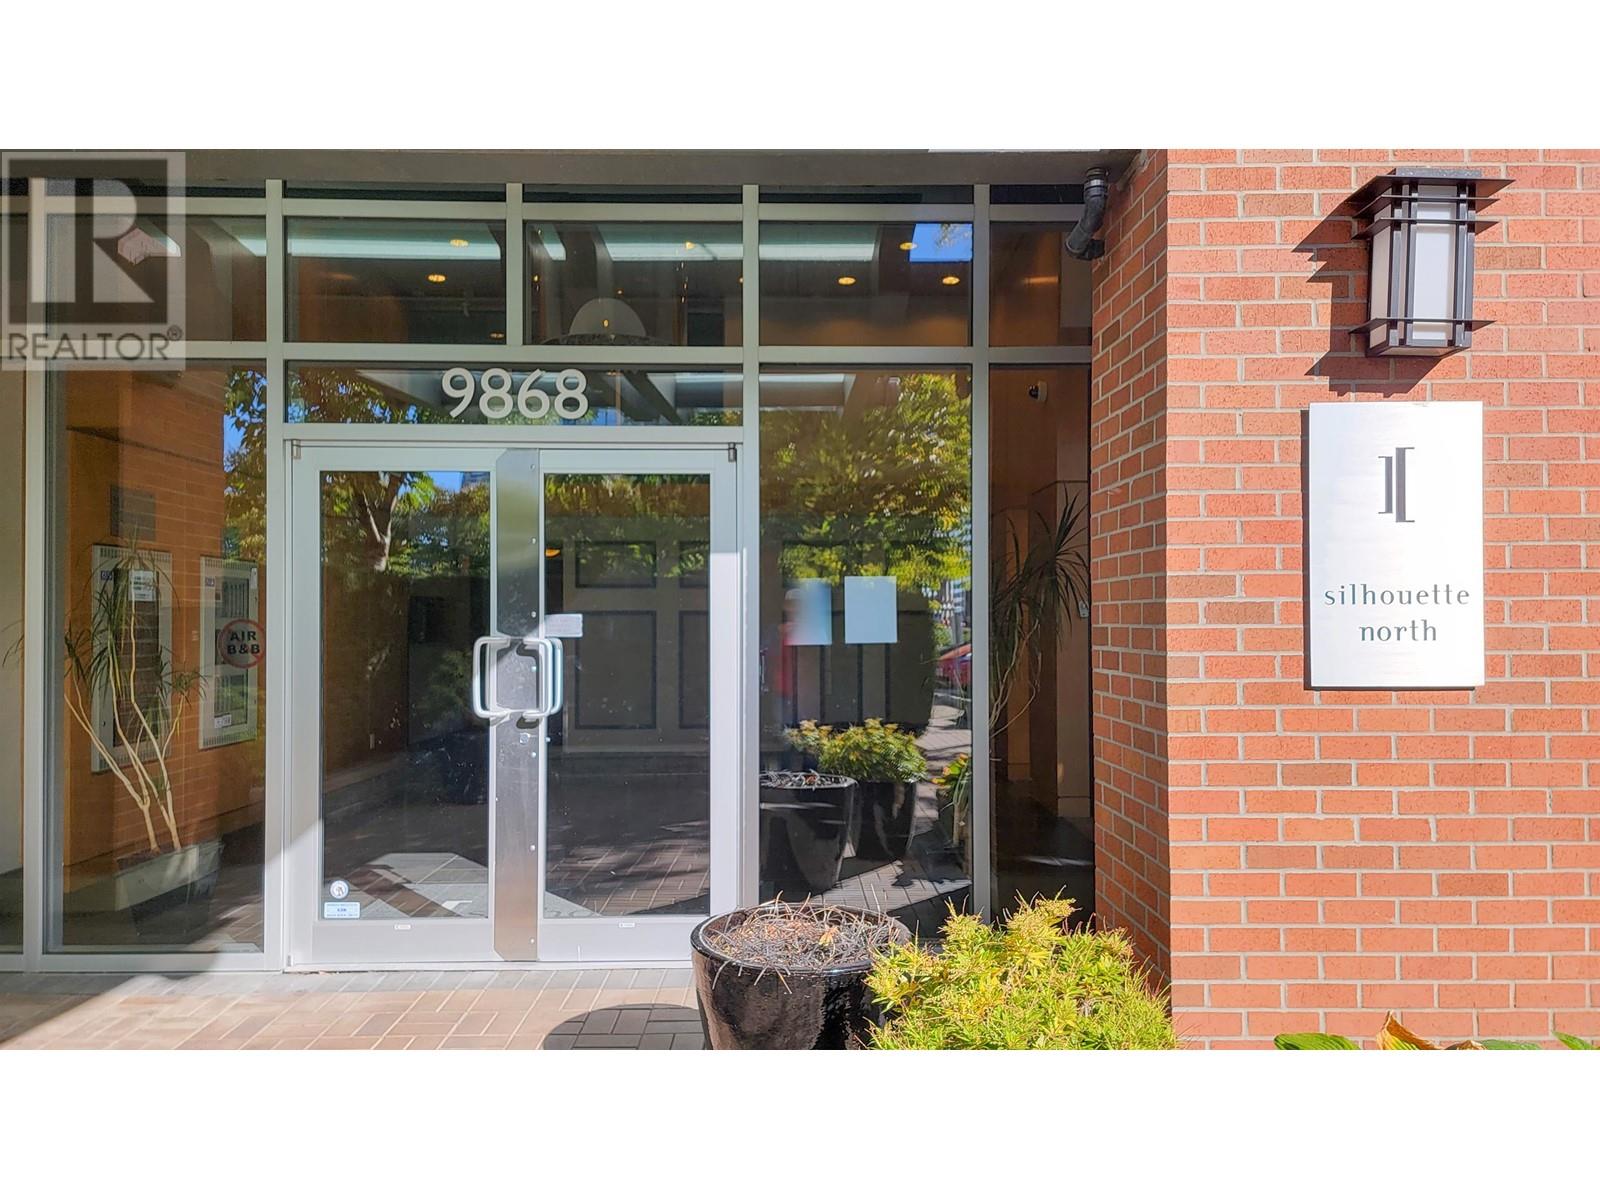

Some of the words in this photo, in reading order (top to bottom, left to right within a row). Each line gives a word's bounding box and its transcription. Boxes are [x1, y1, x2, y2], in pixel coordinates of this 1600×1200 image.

[441, 367, 589, 420] 9868
[1324, 583, 1470, 605] silhouette
[229, 630, 257, 642] AIR
[1358, 619, 1437, 642] north
[226, 645, 261, 656] B&B
